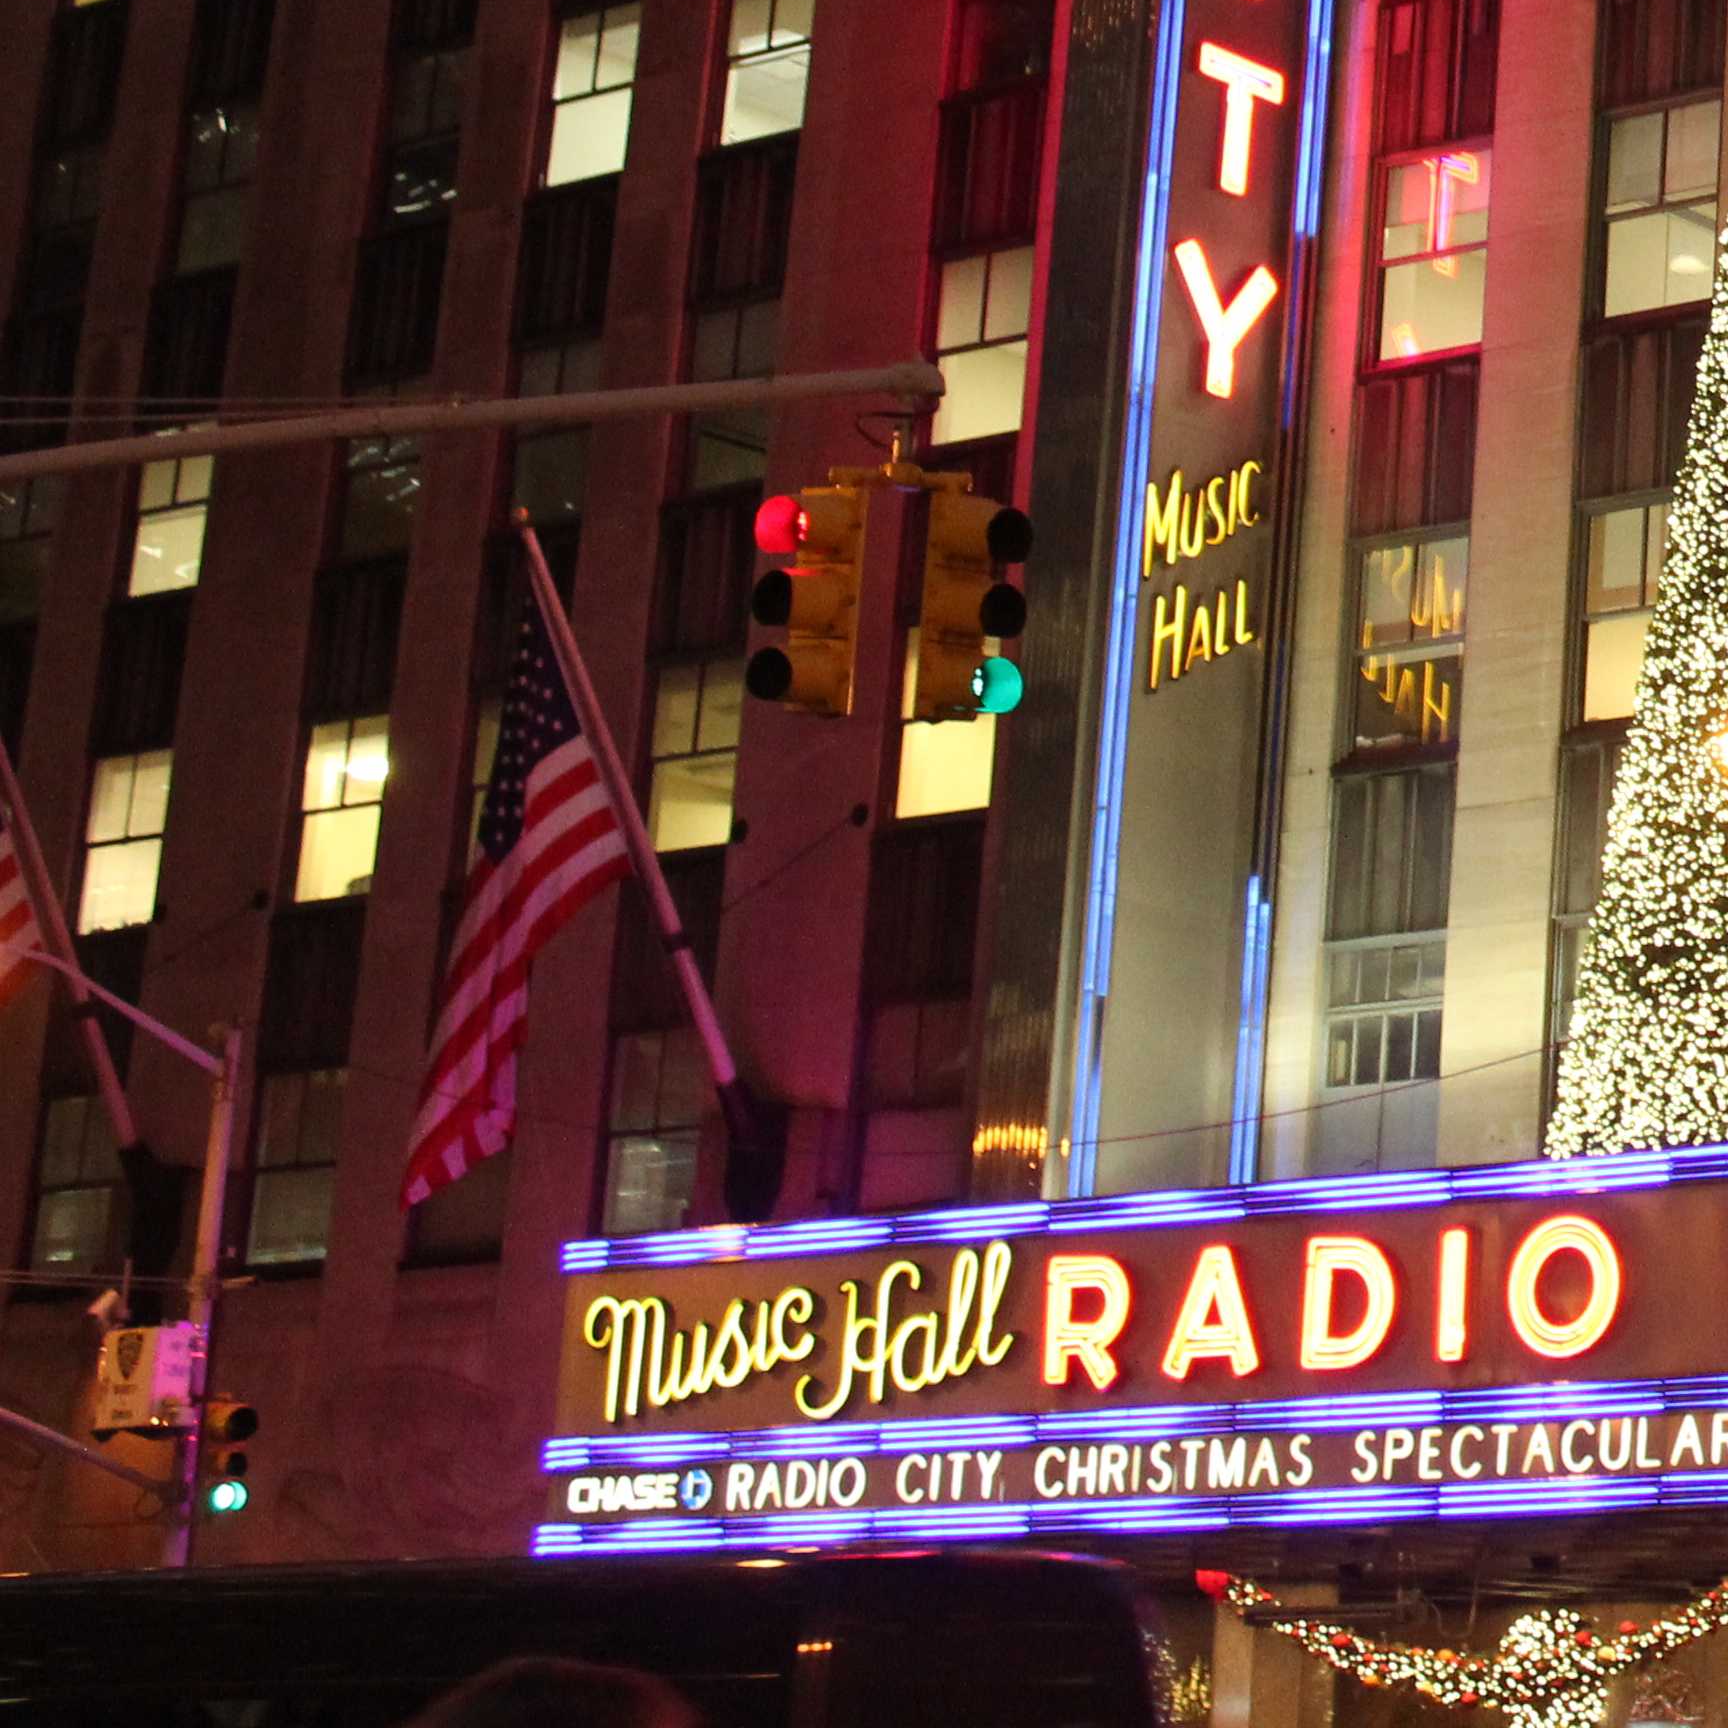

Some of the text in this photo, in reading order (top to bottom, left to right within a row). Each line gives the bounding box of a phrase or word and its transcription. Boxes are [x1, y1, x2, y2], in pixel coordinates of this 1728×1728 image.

[1142, 461, 1260, 580] MUSIC
[1150, 580, 1253, 692] HALL
[584, 1287, 815, 1422] Music
[794, 1240, 1014, 1420] Hall
[1042, 1214, 1622, 1390] RADIO
[567, 1473, 678, 1513] CHASE
[725, 1457, 867, 1512] RADIO
[896, 1451, 1002, 1504] CITY
[1034, 1433, 1313, 1500] CHRISTMAS
